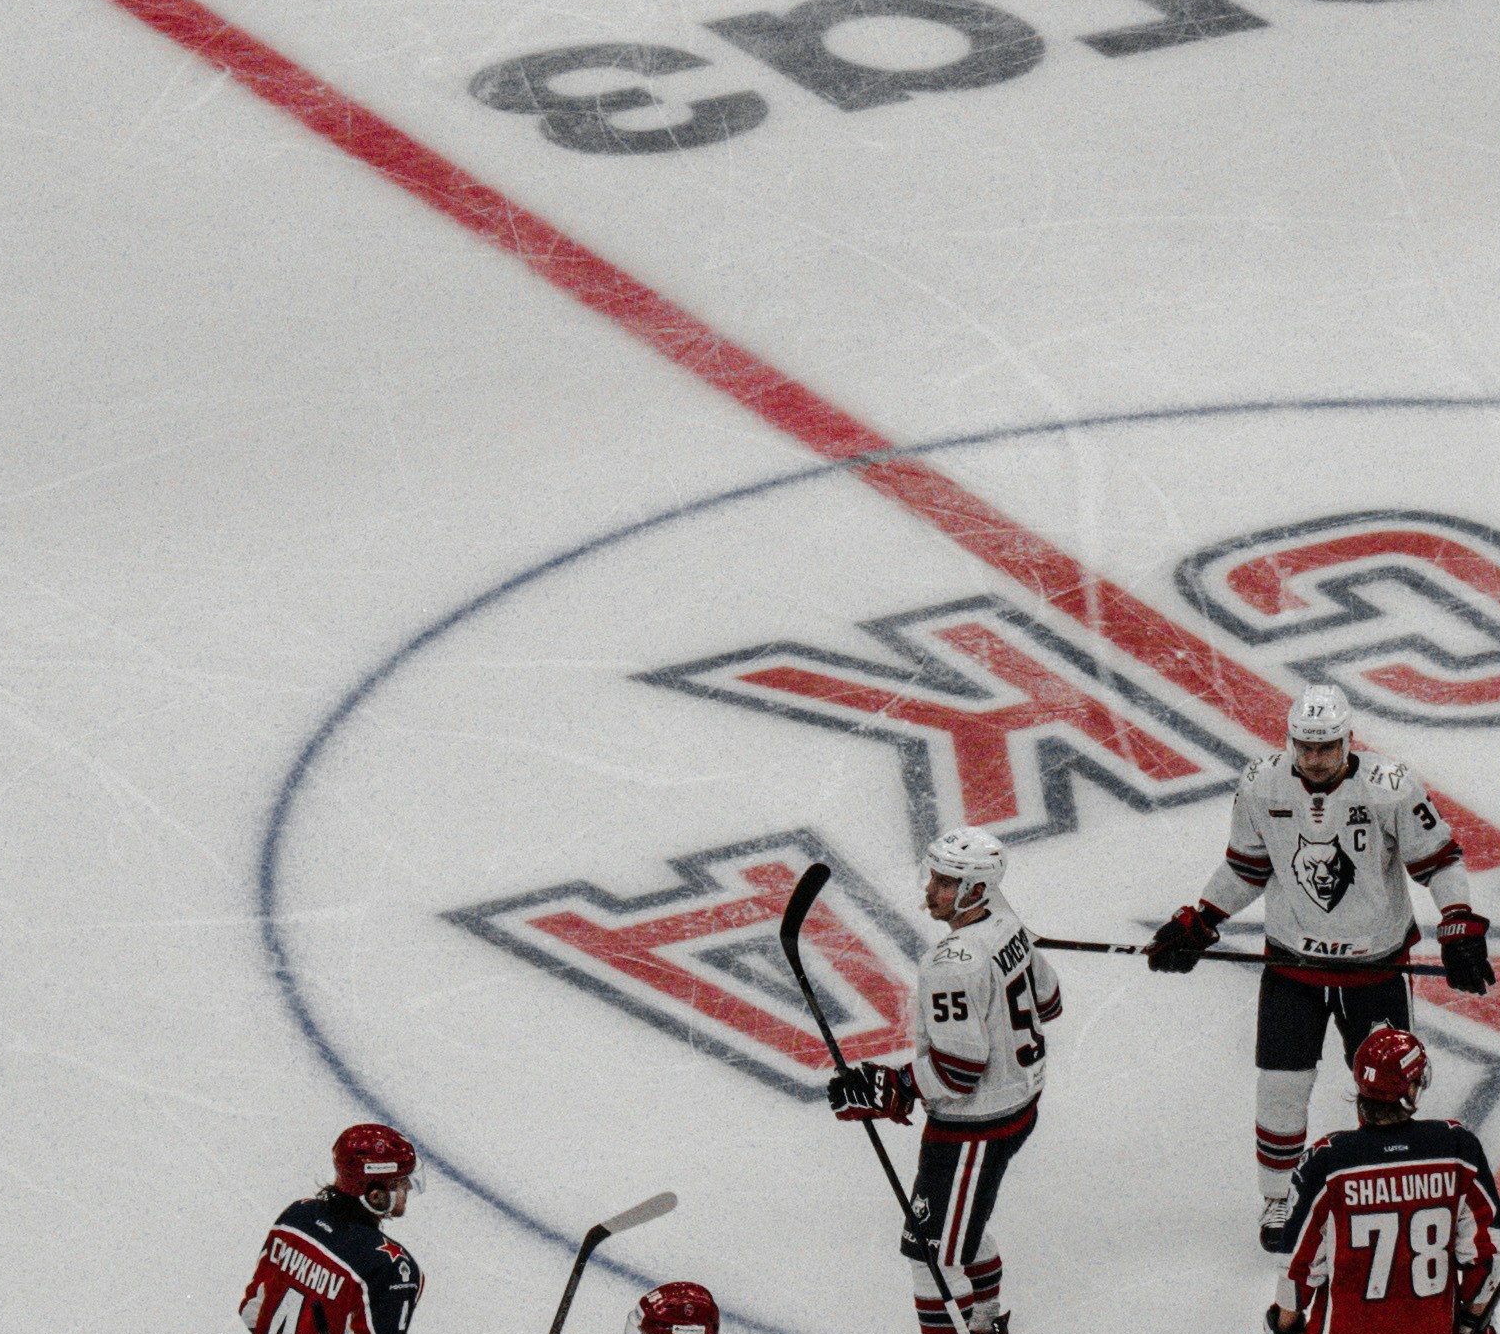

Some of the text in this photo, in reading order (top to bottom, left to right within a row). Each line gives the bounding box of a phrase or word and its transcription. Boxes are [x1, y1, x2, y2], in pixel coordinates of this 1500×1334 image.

[1352, 829, 1367, 853] C
[931, 989, 969, 1023] 55
[1363, 1065, 1377, 1083] 78
[1343, 1170, 1458, 1207] SHALUNOV
[1348, 1205, 1454, 1303] 78
